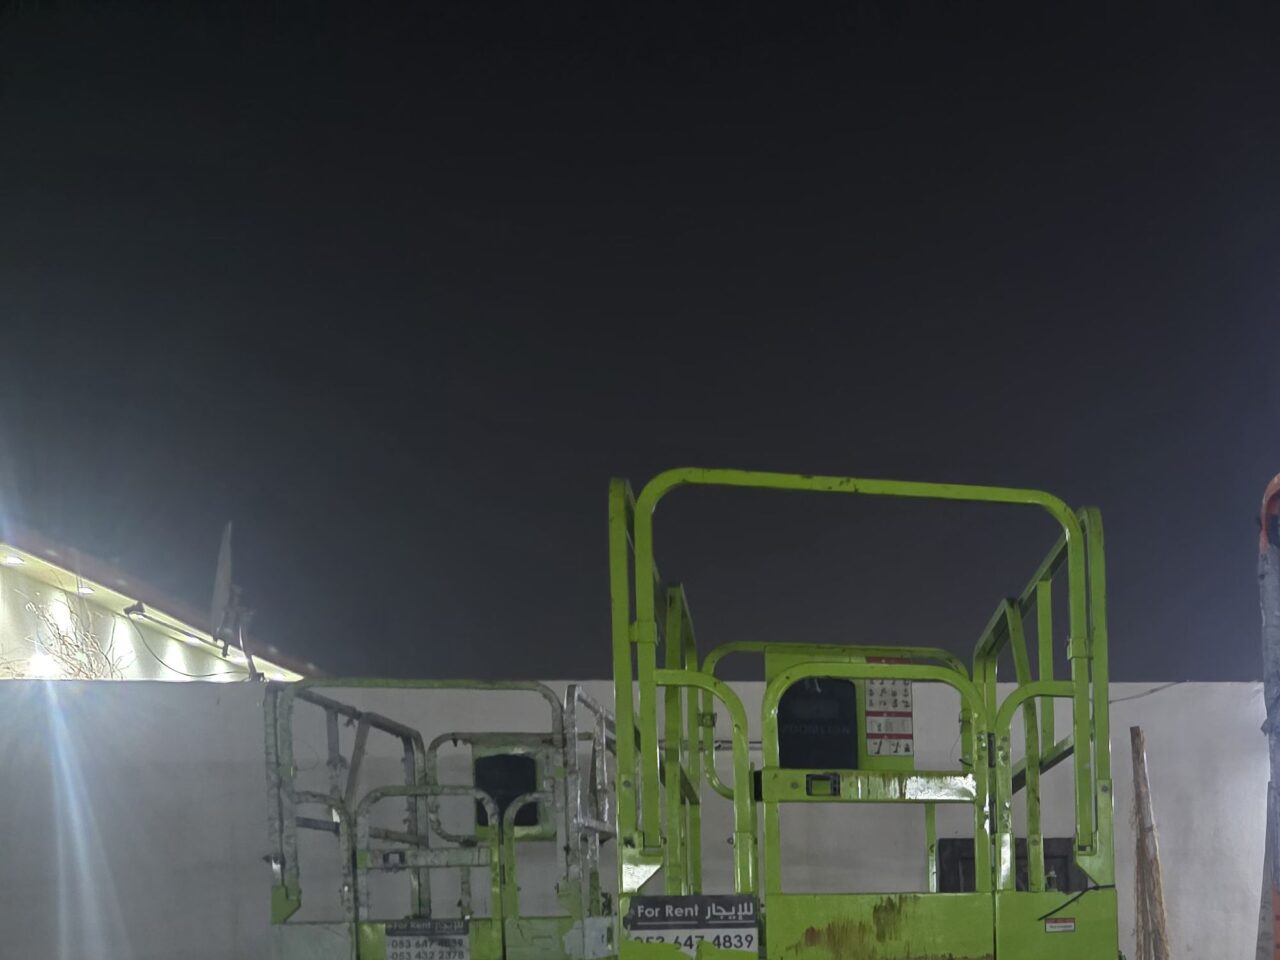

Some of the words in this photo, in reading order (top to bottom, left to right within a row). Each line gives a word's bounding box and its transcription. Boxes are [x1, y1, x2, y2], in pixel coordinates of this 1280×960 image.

[637, 904, 660, 918] For
[665, 904, 699, 918] Rent
[705, 902, 754, 920] للإيجار
[712, 934, 754, 949] 4839
